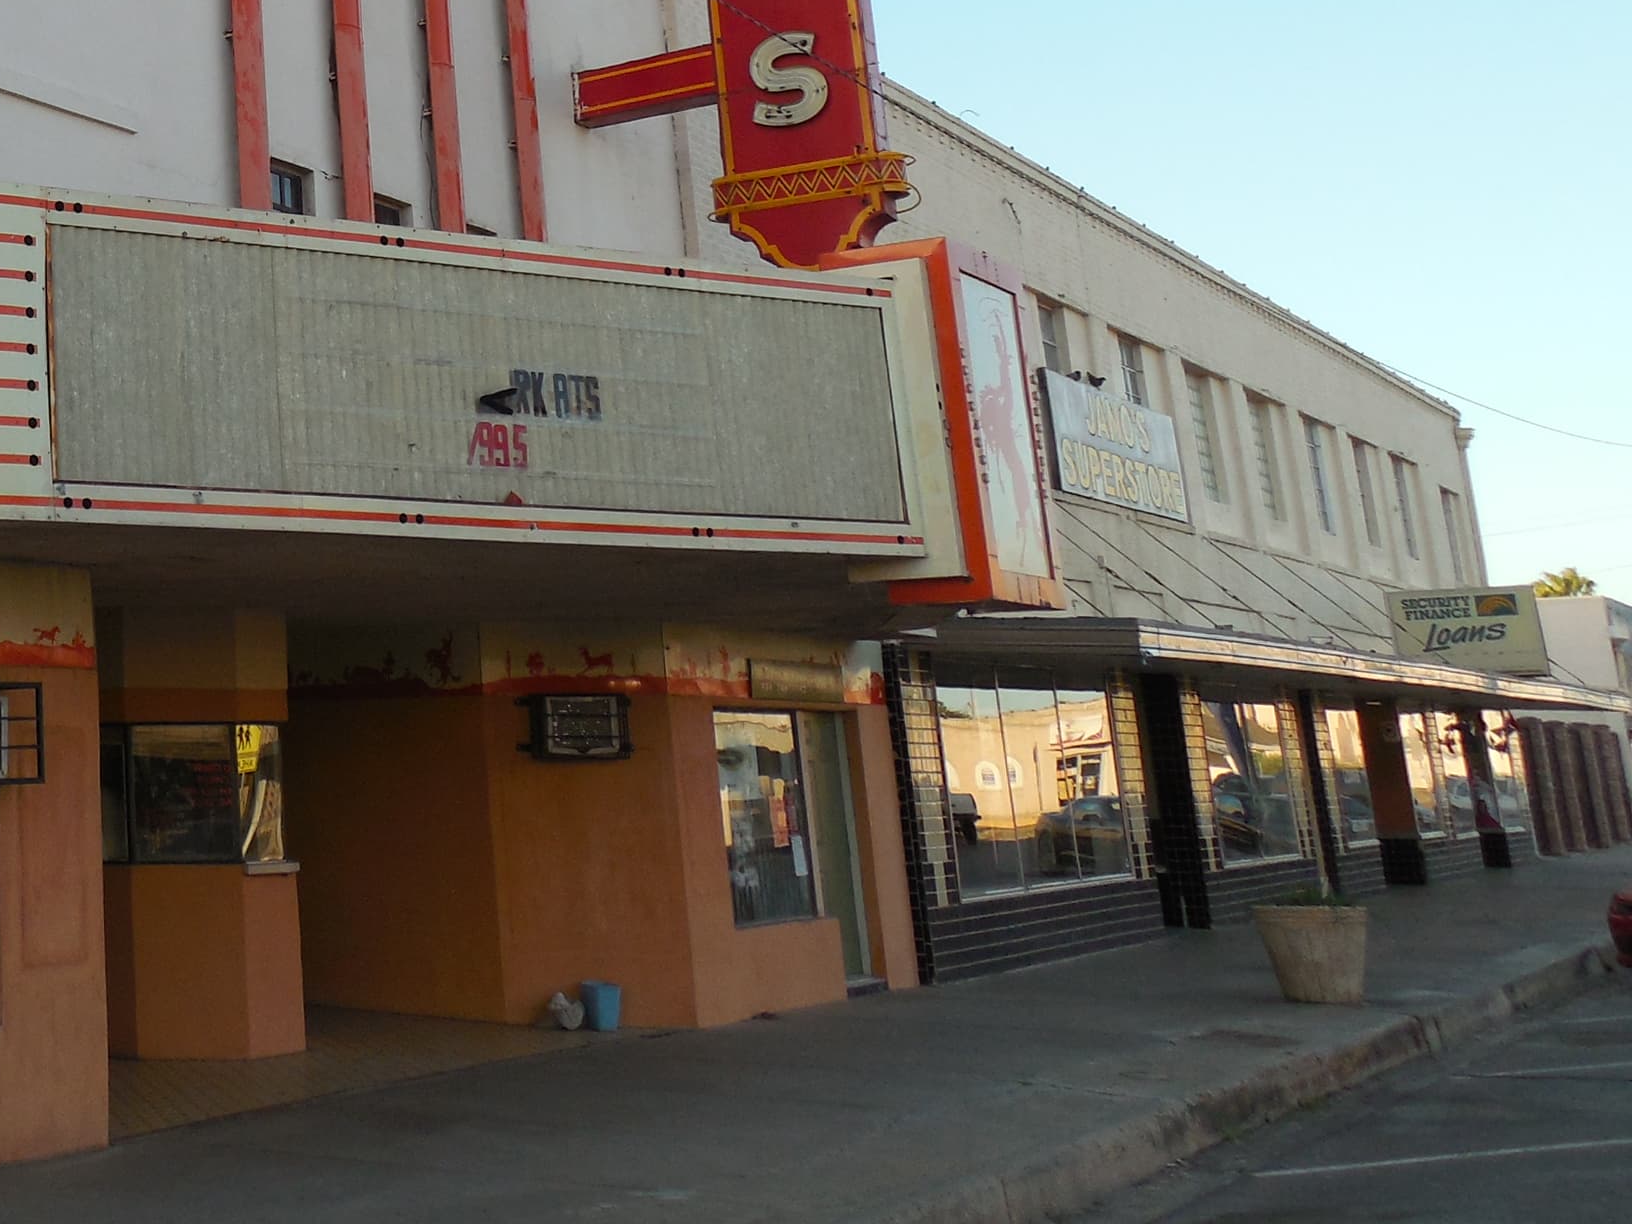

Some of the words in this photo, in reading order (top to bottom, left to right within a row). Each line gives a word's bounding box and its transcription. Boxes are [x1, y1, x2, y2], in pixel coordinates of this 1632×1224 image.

[1061, 437, 1186, 515] SUPERSTORE
[1401, 596, 1470, 610] SECURITY
[1405, 608, 1471, 621] FINANCE
[1422, 622, 1507, 653] Loans
